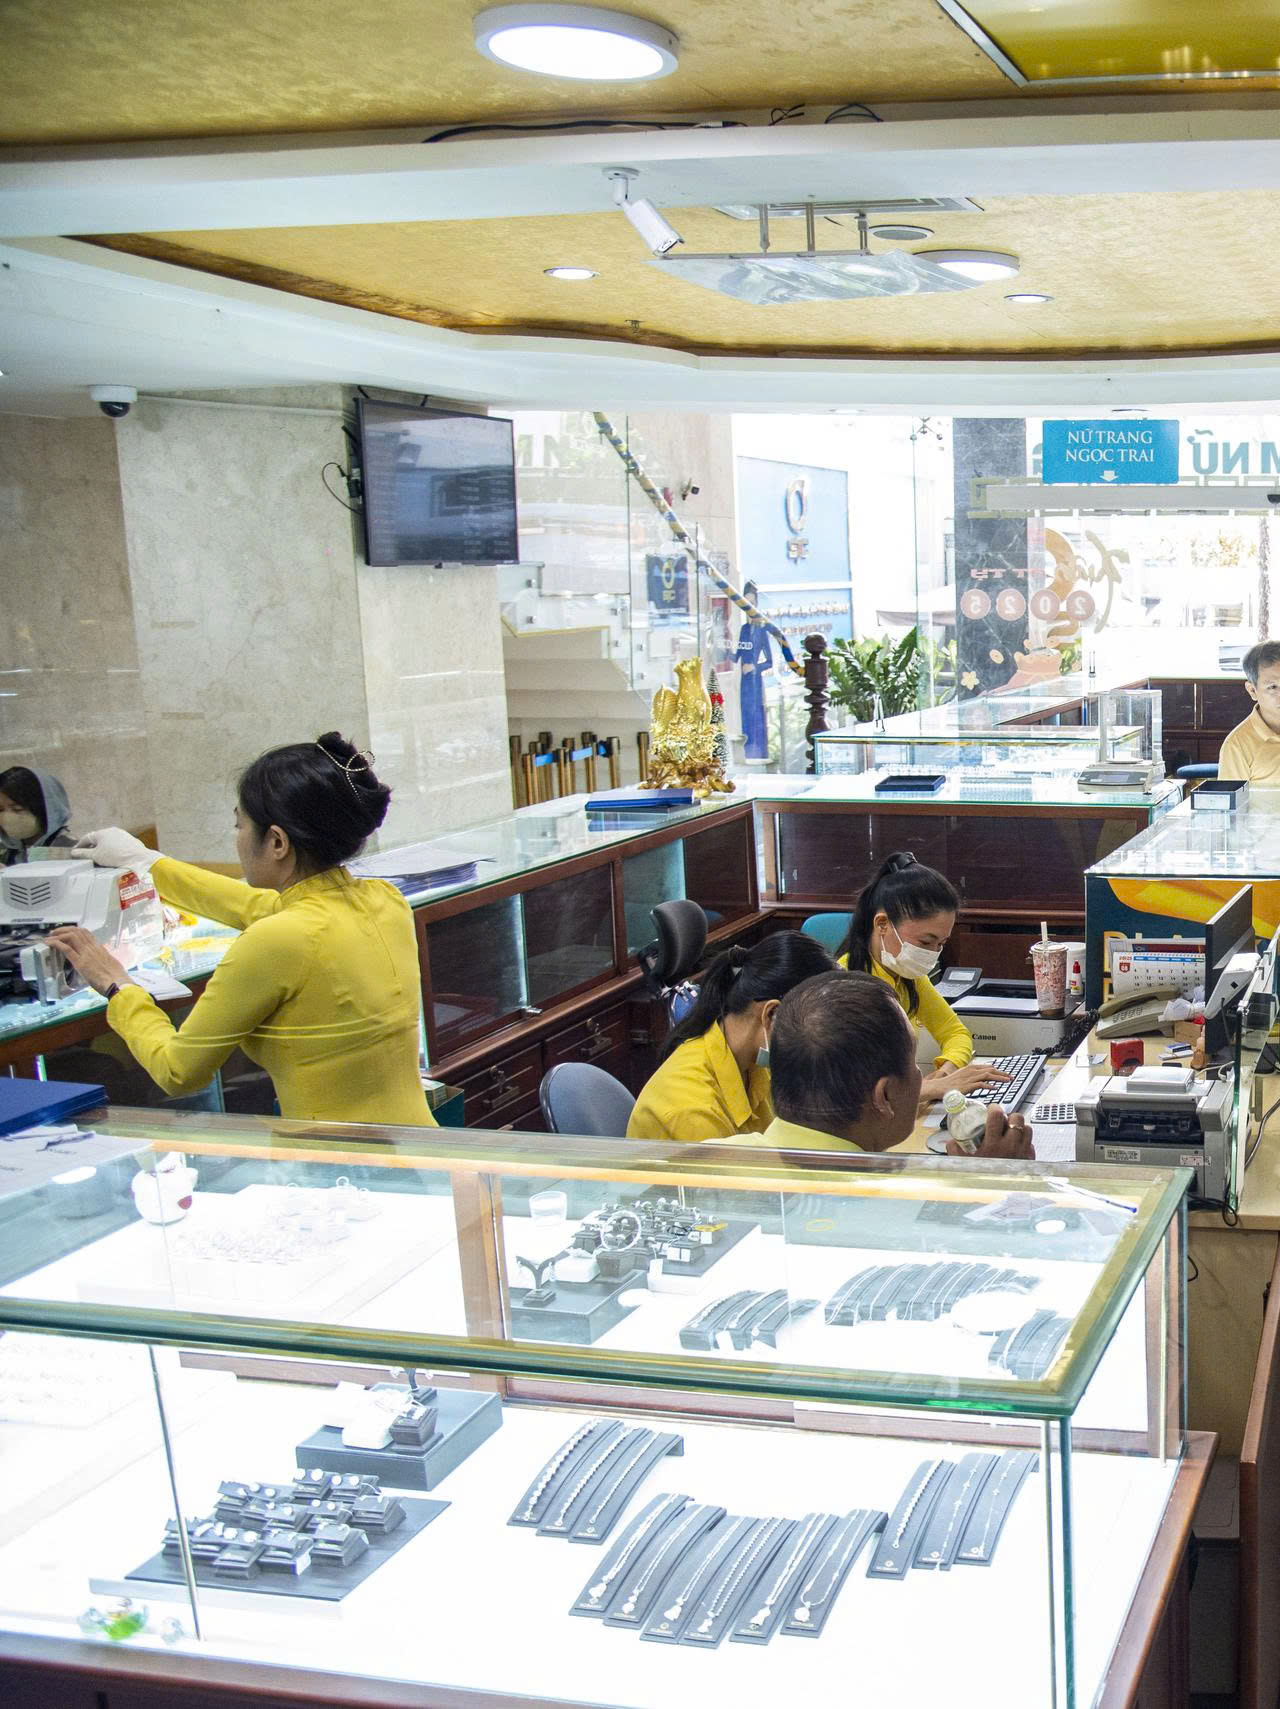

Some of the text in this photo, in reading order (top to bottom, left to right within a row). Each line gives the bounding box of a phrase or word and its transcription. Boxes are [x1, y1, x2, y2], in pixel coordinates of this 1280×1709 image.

[1095, 431, 1152, 444] TRANG
[1065, 449, 1154, 464] NGỌC TRAI
[972, 1033, 996, 1041] Canon
